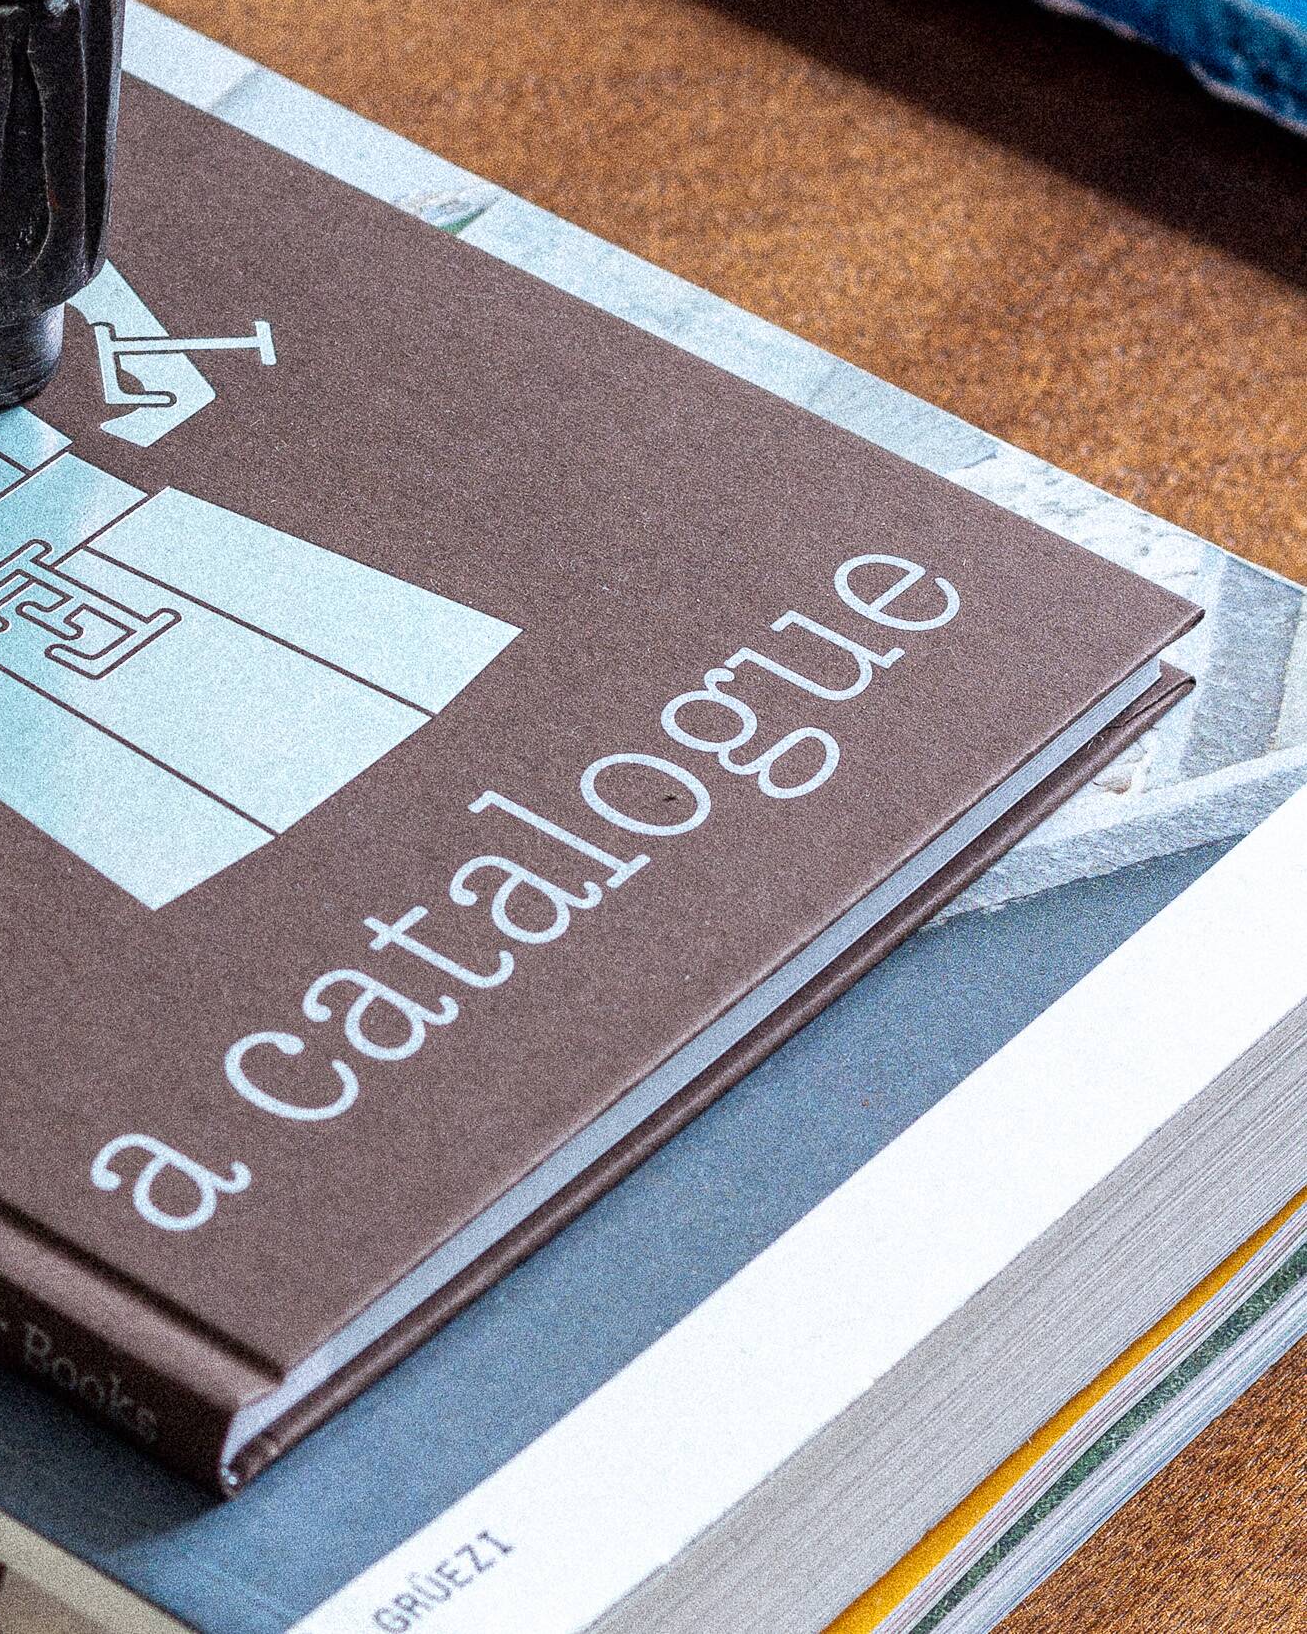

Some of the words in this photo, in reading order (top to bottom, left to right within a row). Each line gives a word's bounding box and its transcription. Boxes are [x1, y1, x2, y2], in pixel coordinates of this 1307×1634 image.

[91, 1131, 252, 1232] a
[222, 552, 962, 1124] catalogue
[23, 1323, 158, 1442] Books
[373, 1530, 515, 1634] GRÜEZI
